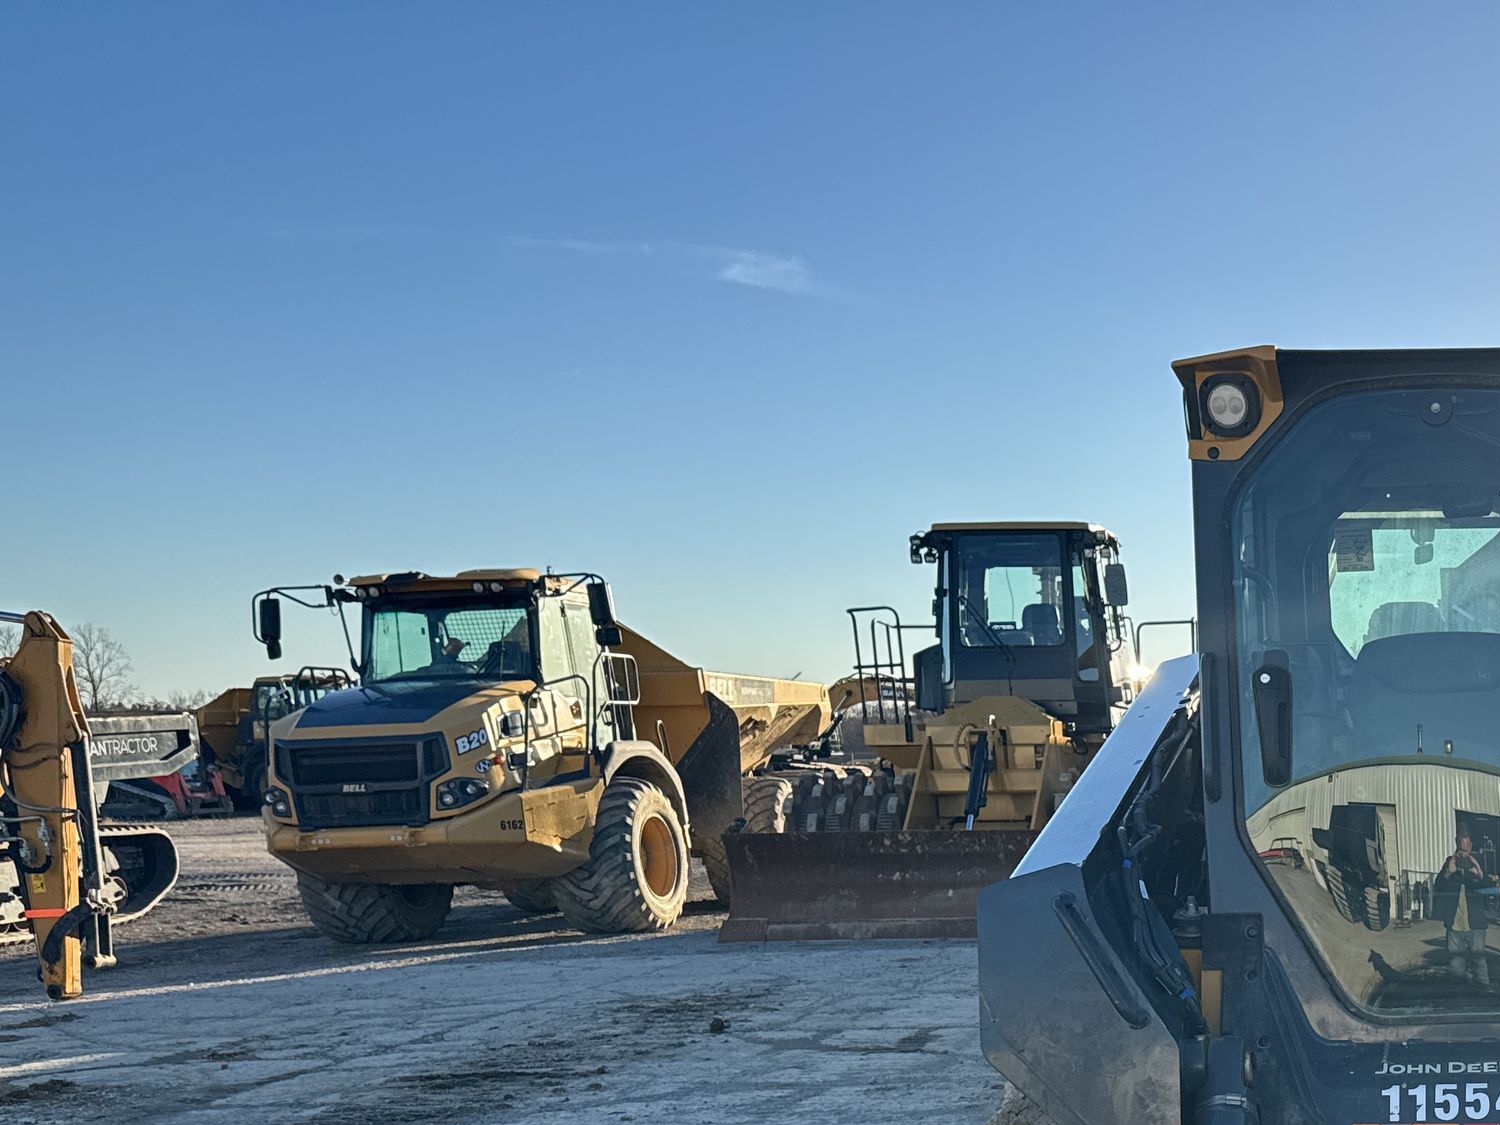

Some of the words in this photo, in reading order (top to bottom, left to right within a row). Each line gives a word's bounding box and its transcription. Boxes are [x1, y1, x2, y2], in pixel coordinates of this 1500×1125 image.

[89, 737, 158, 756] ANTRACTOR
[342, 783, 367, 793] BELL
[500, 819, 524, 831] 6162
[1374, 1061, 1442, 1075] JOHN
